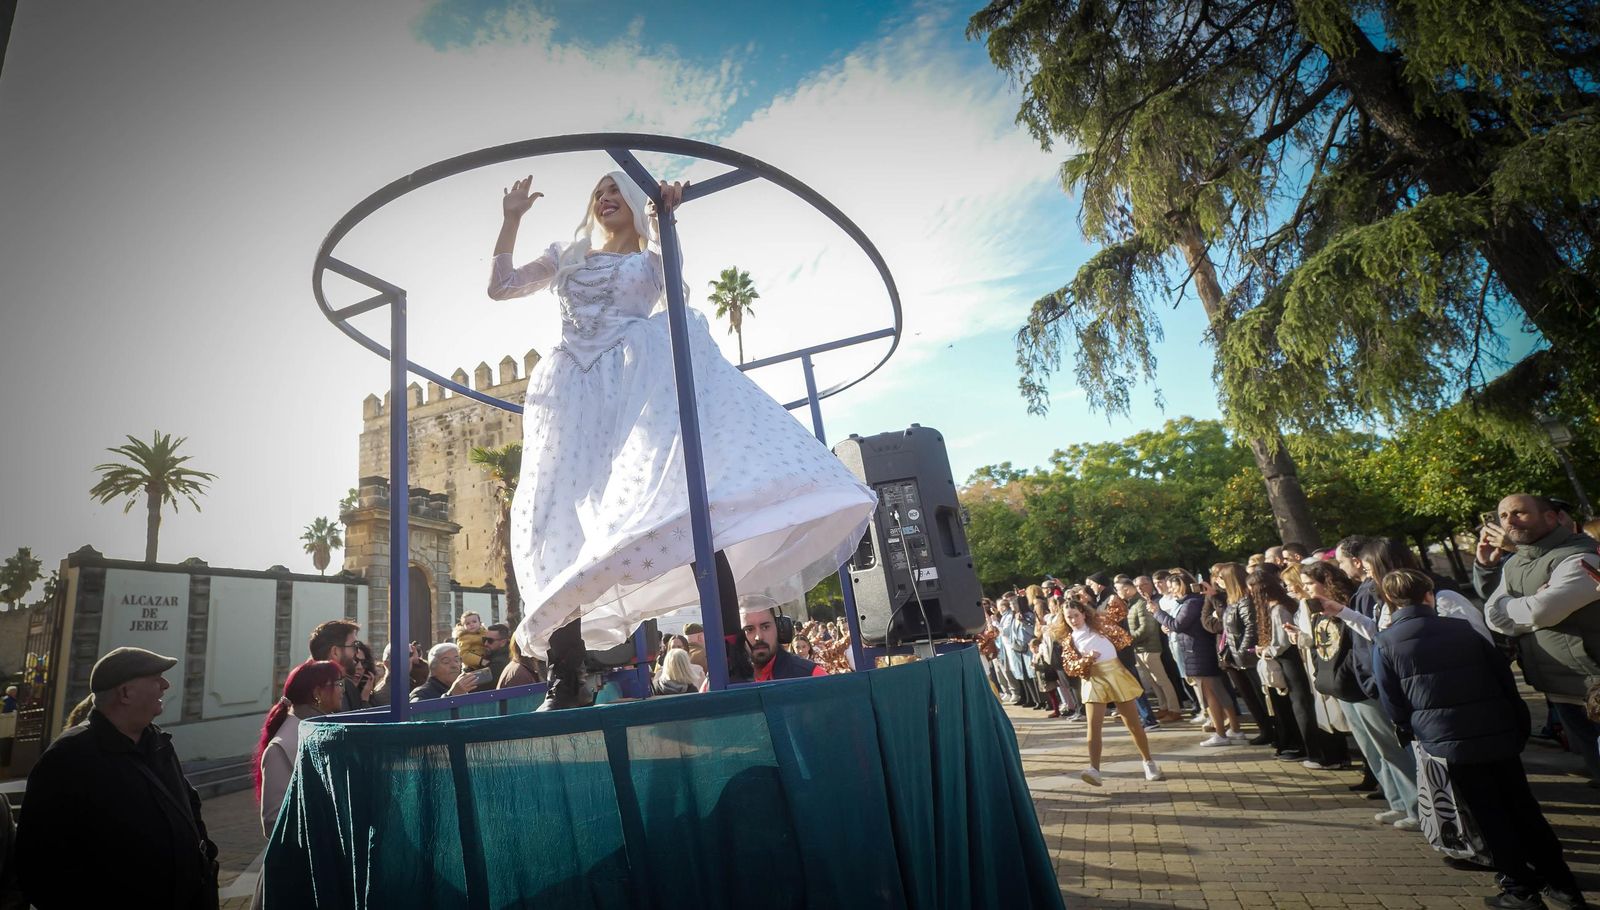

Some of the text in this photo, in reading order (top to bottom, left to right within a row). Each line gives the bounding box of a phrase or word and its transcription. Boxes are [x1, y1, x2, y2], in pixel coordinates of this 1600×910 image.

[120, 594, 179, 607] ALCAZAR
[141, 607, 159, 619] DE
[129, 620, 169, 632] JEREZ
